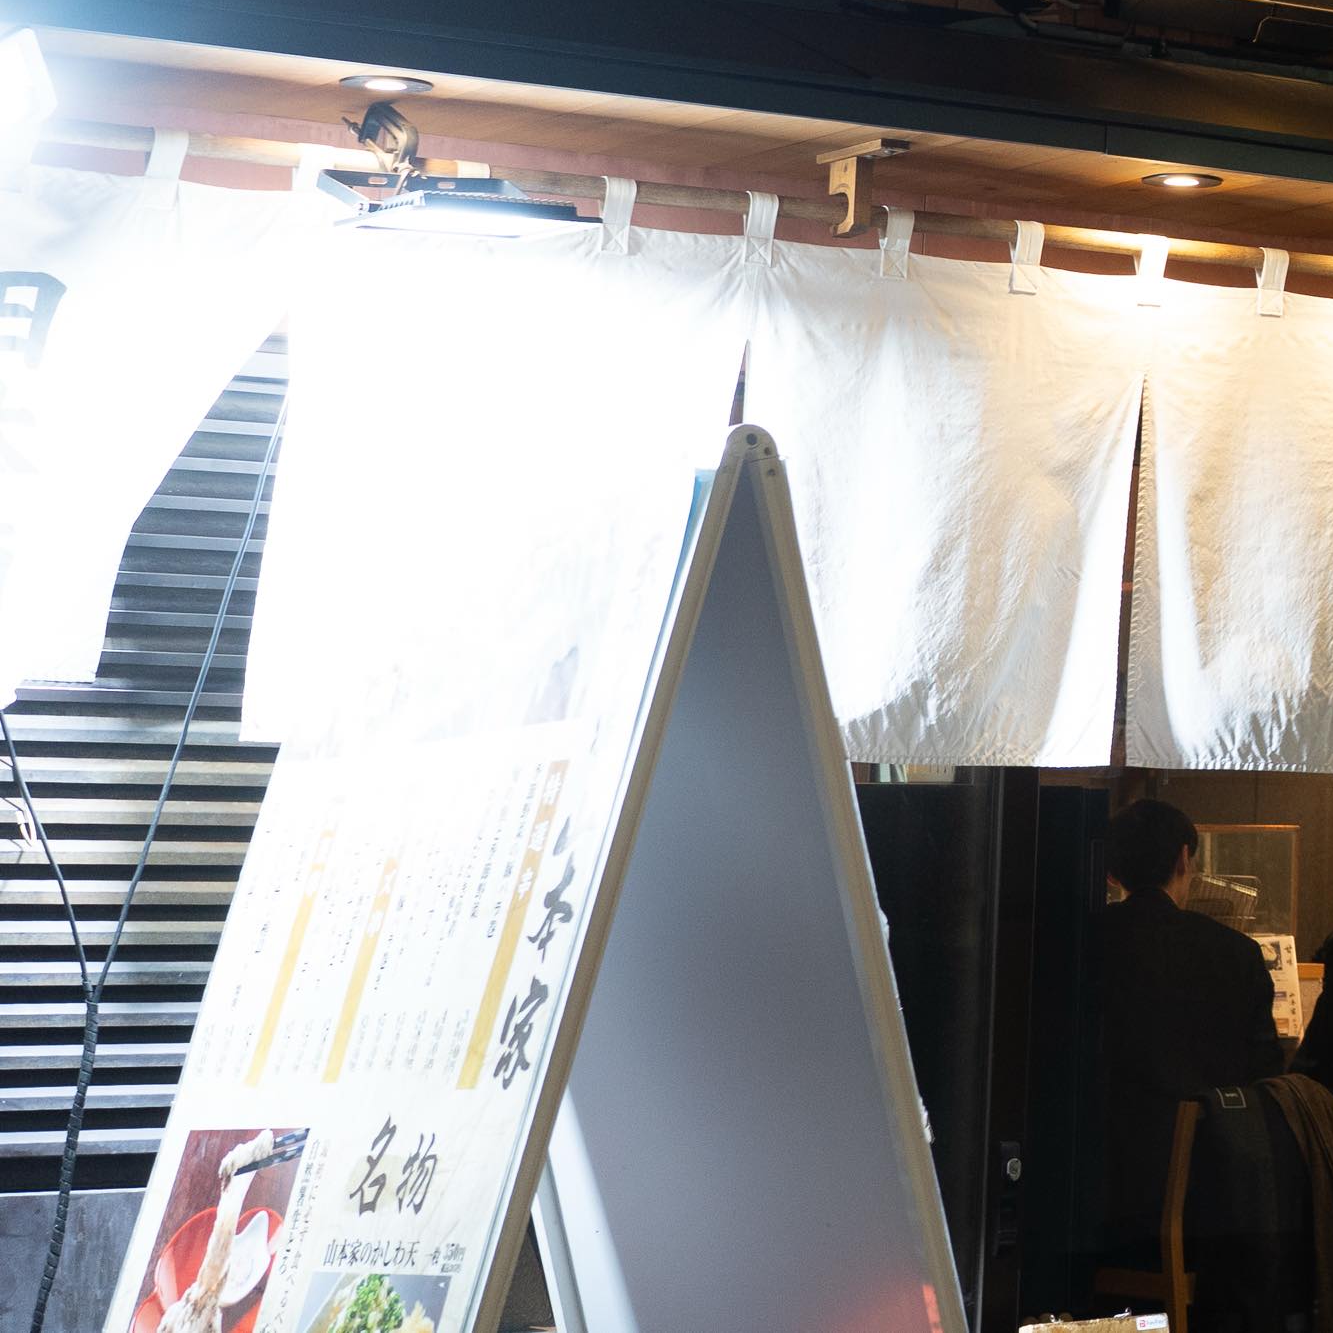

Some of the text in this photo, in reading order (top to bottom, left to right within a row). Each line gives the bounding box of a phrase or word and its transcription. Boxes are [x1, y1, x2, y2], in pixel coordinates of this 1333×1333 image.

[349, 1113, 438, 1216] 名物
[323, 1238, 420, 1268] 山本家のかしわ天
